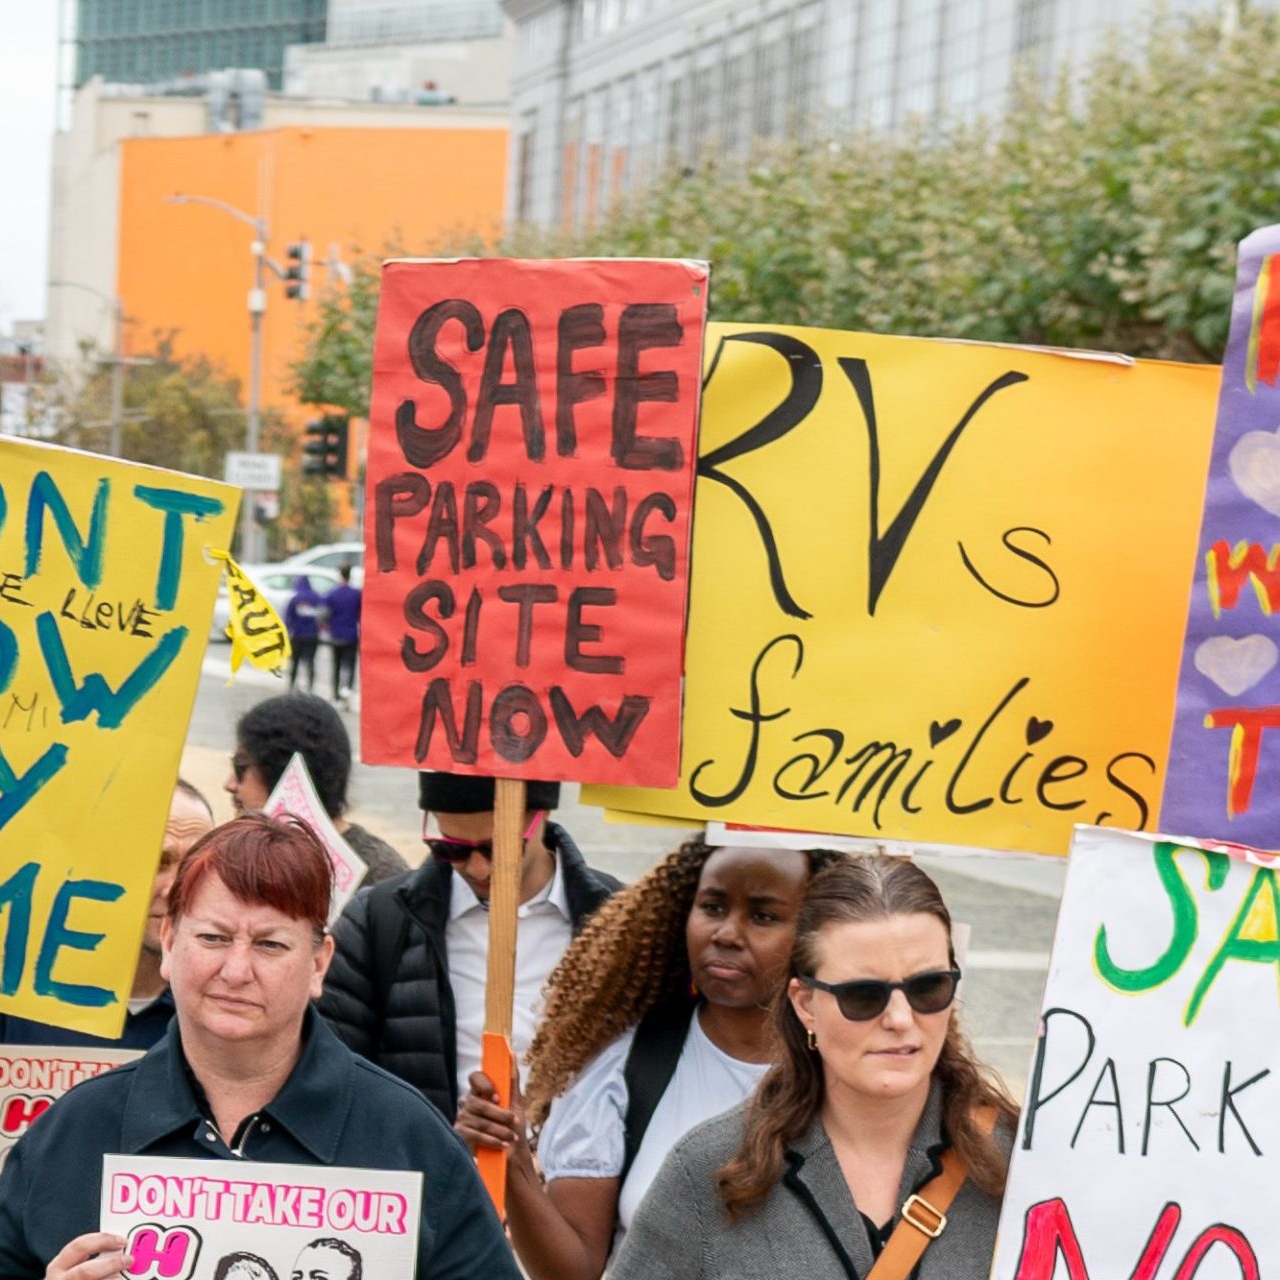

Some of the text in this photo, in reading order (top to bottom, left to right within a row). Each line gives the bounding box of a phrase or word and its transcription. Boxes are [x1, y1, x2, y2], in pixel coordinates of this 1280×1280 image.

[395, 299, 686, 471] SAFE
[375, 472, 679, 582] PARKING
[400, 579, 626, 675] SITE
[414, 677, 651, 765] NOW
[689, 633, 1157, 832] families
[1021, 1007, 1272, 1157] PARK
[110, 1172, 408, 1235] DON'T TAKE OUR
